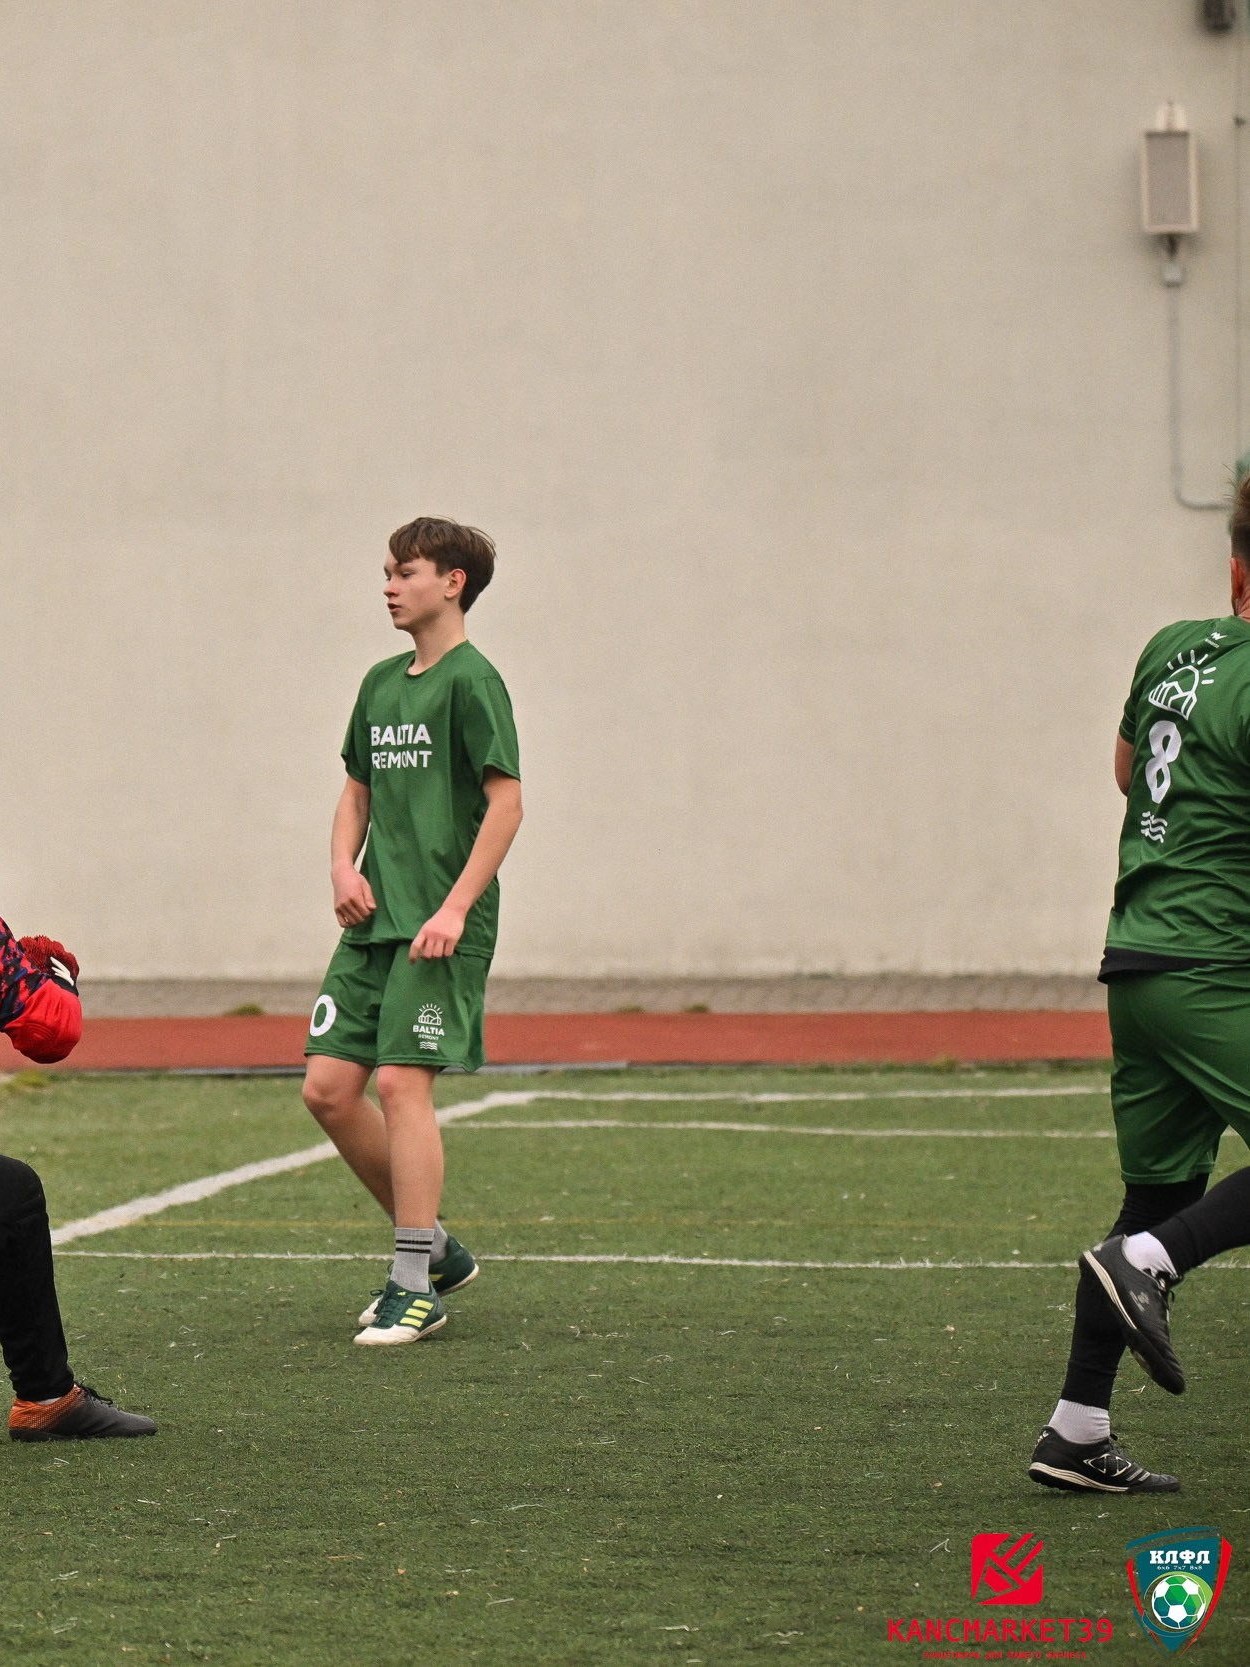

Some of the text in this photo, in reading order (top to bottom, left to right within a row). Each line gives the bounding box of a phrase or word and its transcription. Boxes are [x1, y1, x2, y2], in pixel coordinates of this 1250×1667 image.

[371, 723, 432, 747] BALTIA
[371, 750, 432, 769] REMONT
[1145, 720, 1181, 803] 8
[412, 1024, 445, 1036] BALTIA
